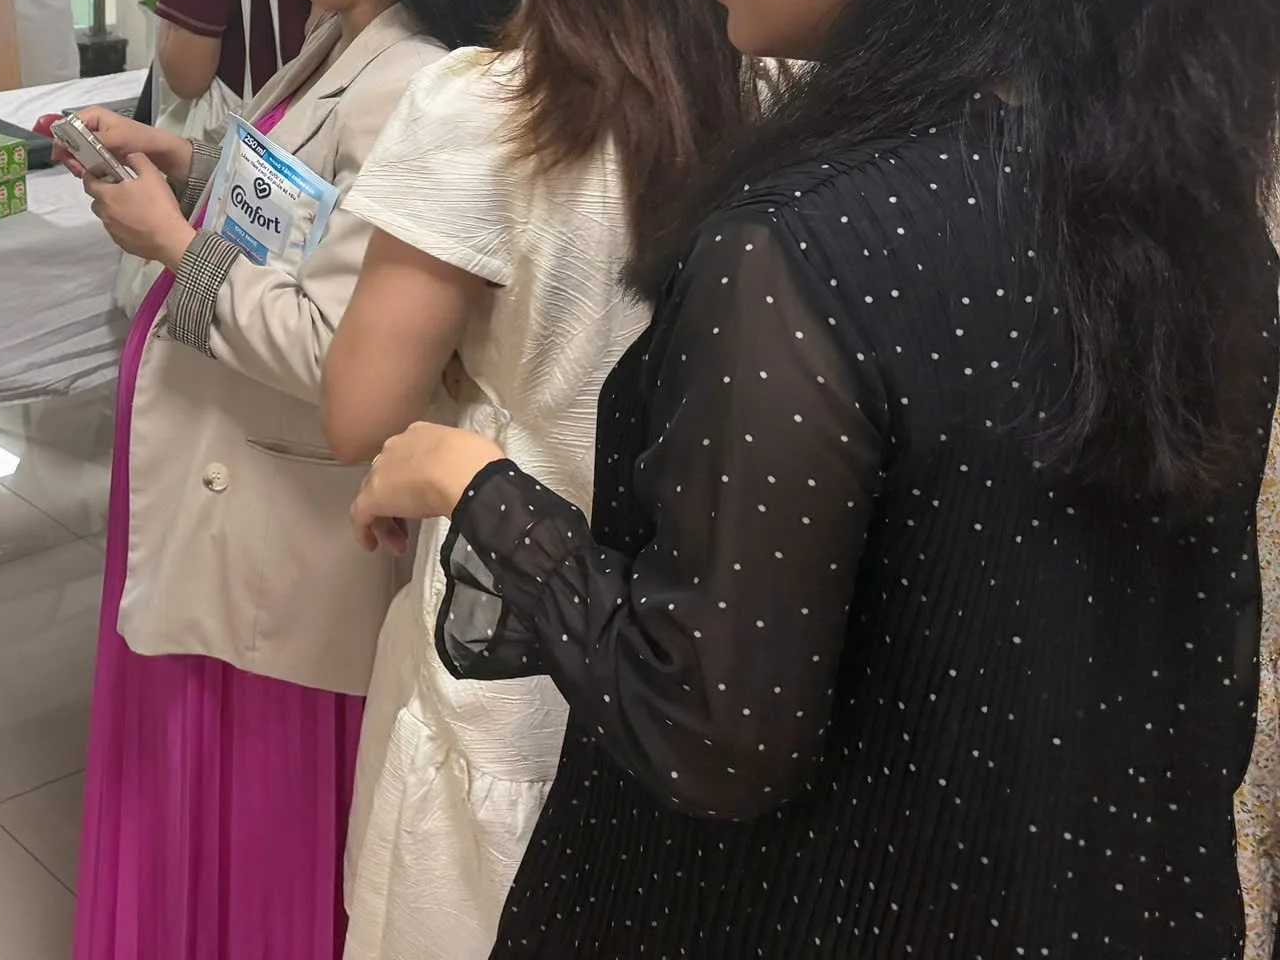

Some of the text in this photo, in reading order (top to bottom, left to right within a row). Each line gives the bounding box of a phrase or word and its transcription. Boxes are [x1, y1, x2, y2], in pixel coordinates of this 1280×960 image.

[243, 134, 266, 156] 250 ml
[231, 185, 281, 234] Comfort
